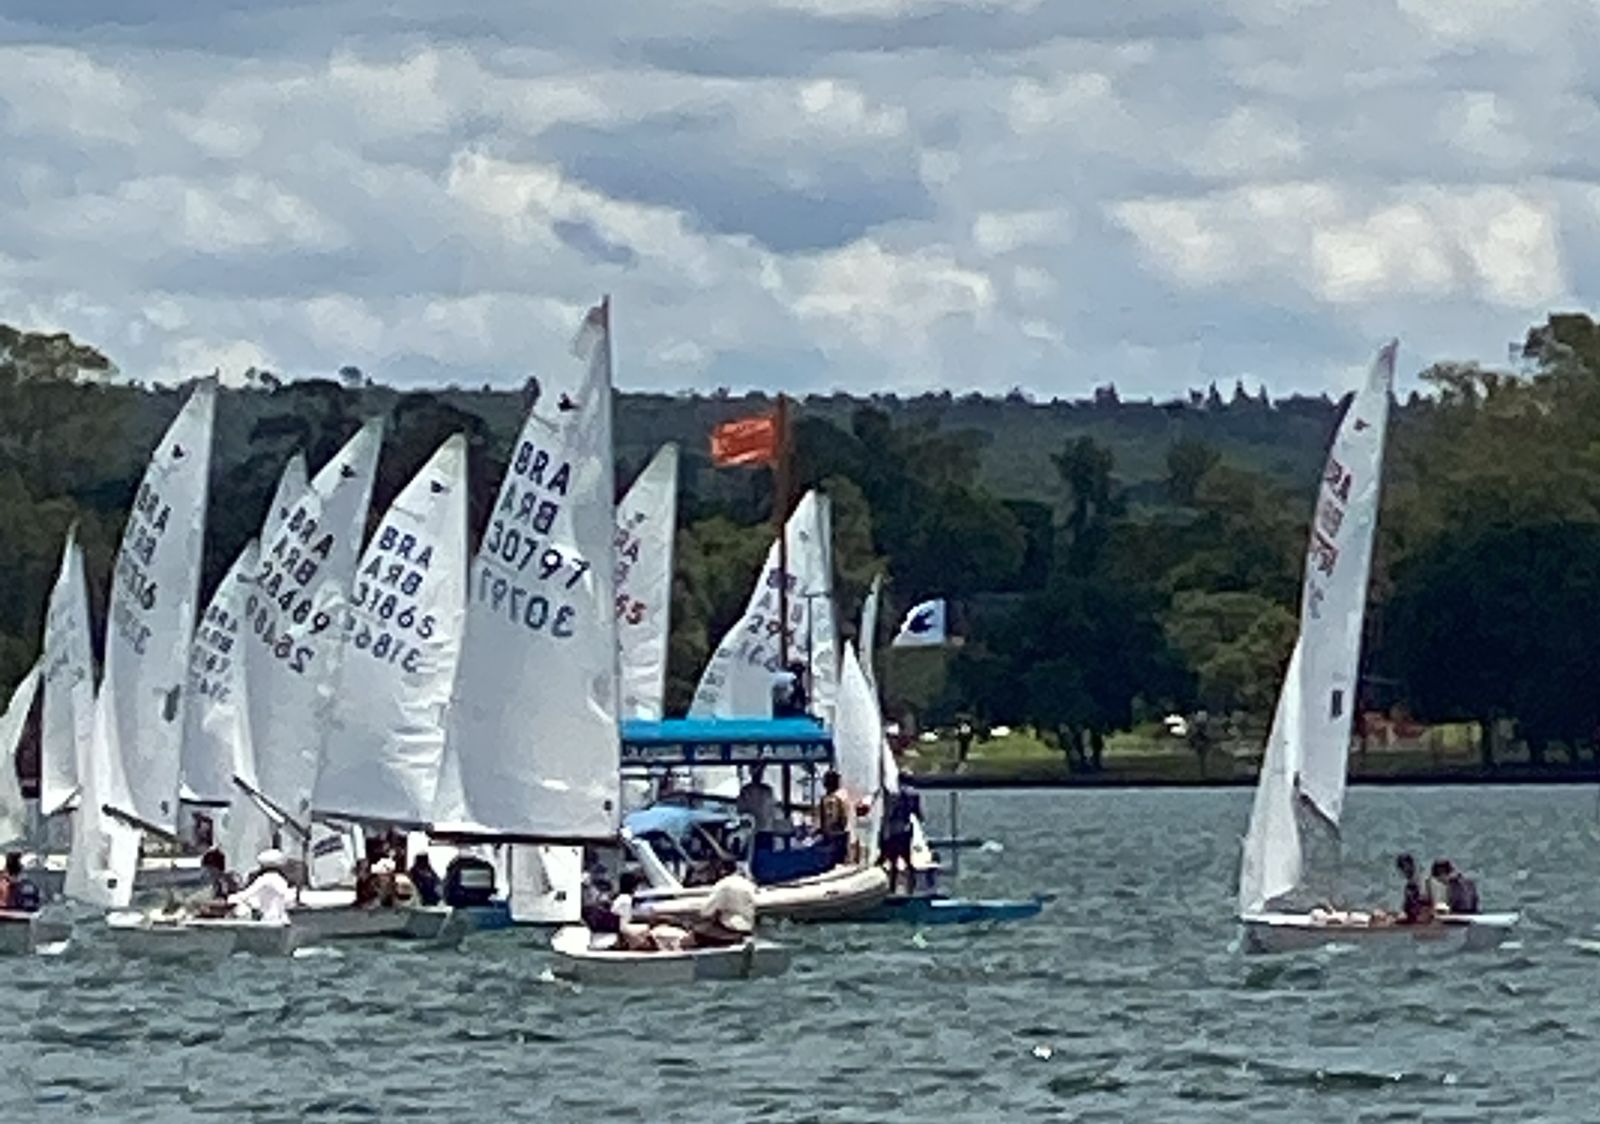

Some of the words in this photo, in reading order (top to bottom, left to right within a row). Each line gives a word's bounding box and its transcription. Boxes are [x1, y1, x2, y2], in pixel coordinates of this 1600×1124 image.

[514, 441, 572, 496] BRA
[287, 506, 335, 561] BRA
[378, 524, 435, 571] BRA
[487, 519, 592, 590] 30797
[614, 528, 640, 564] RA
